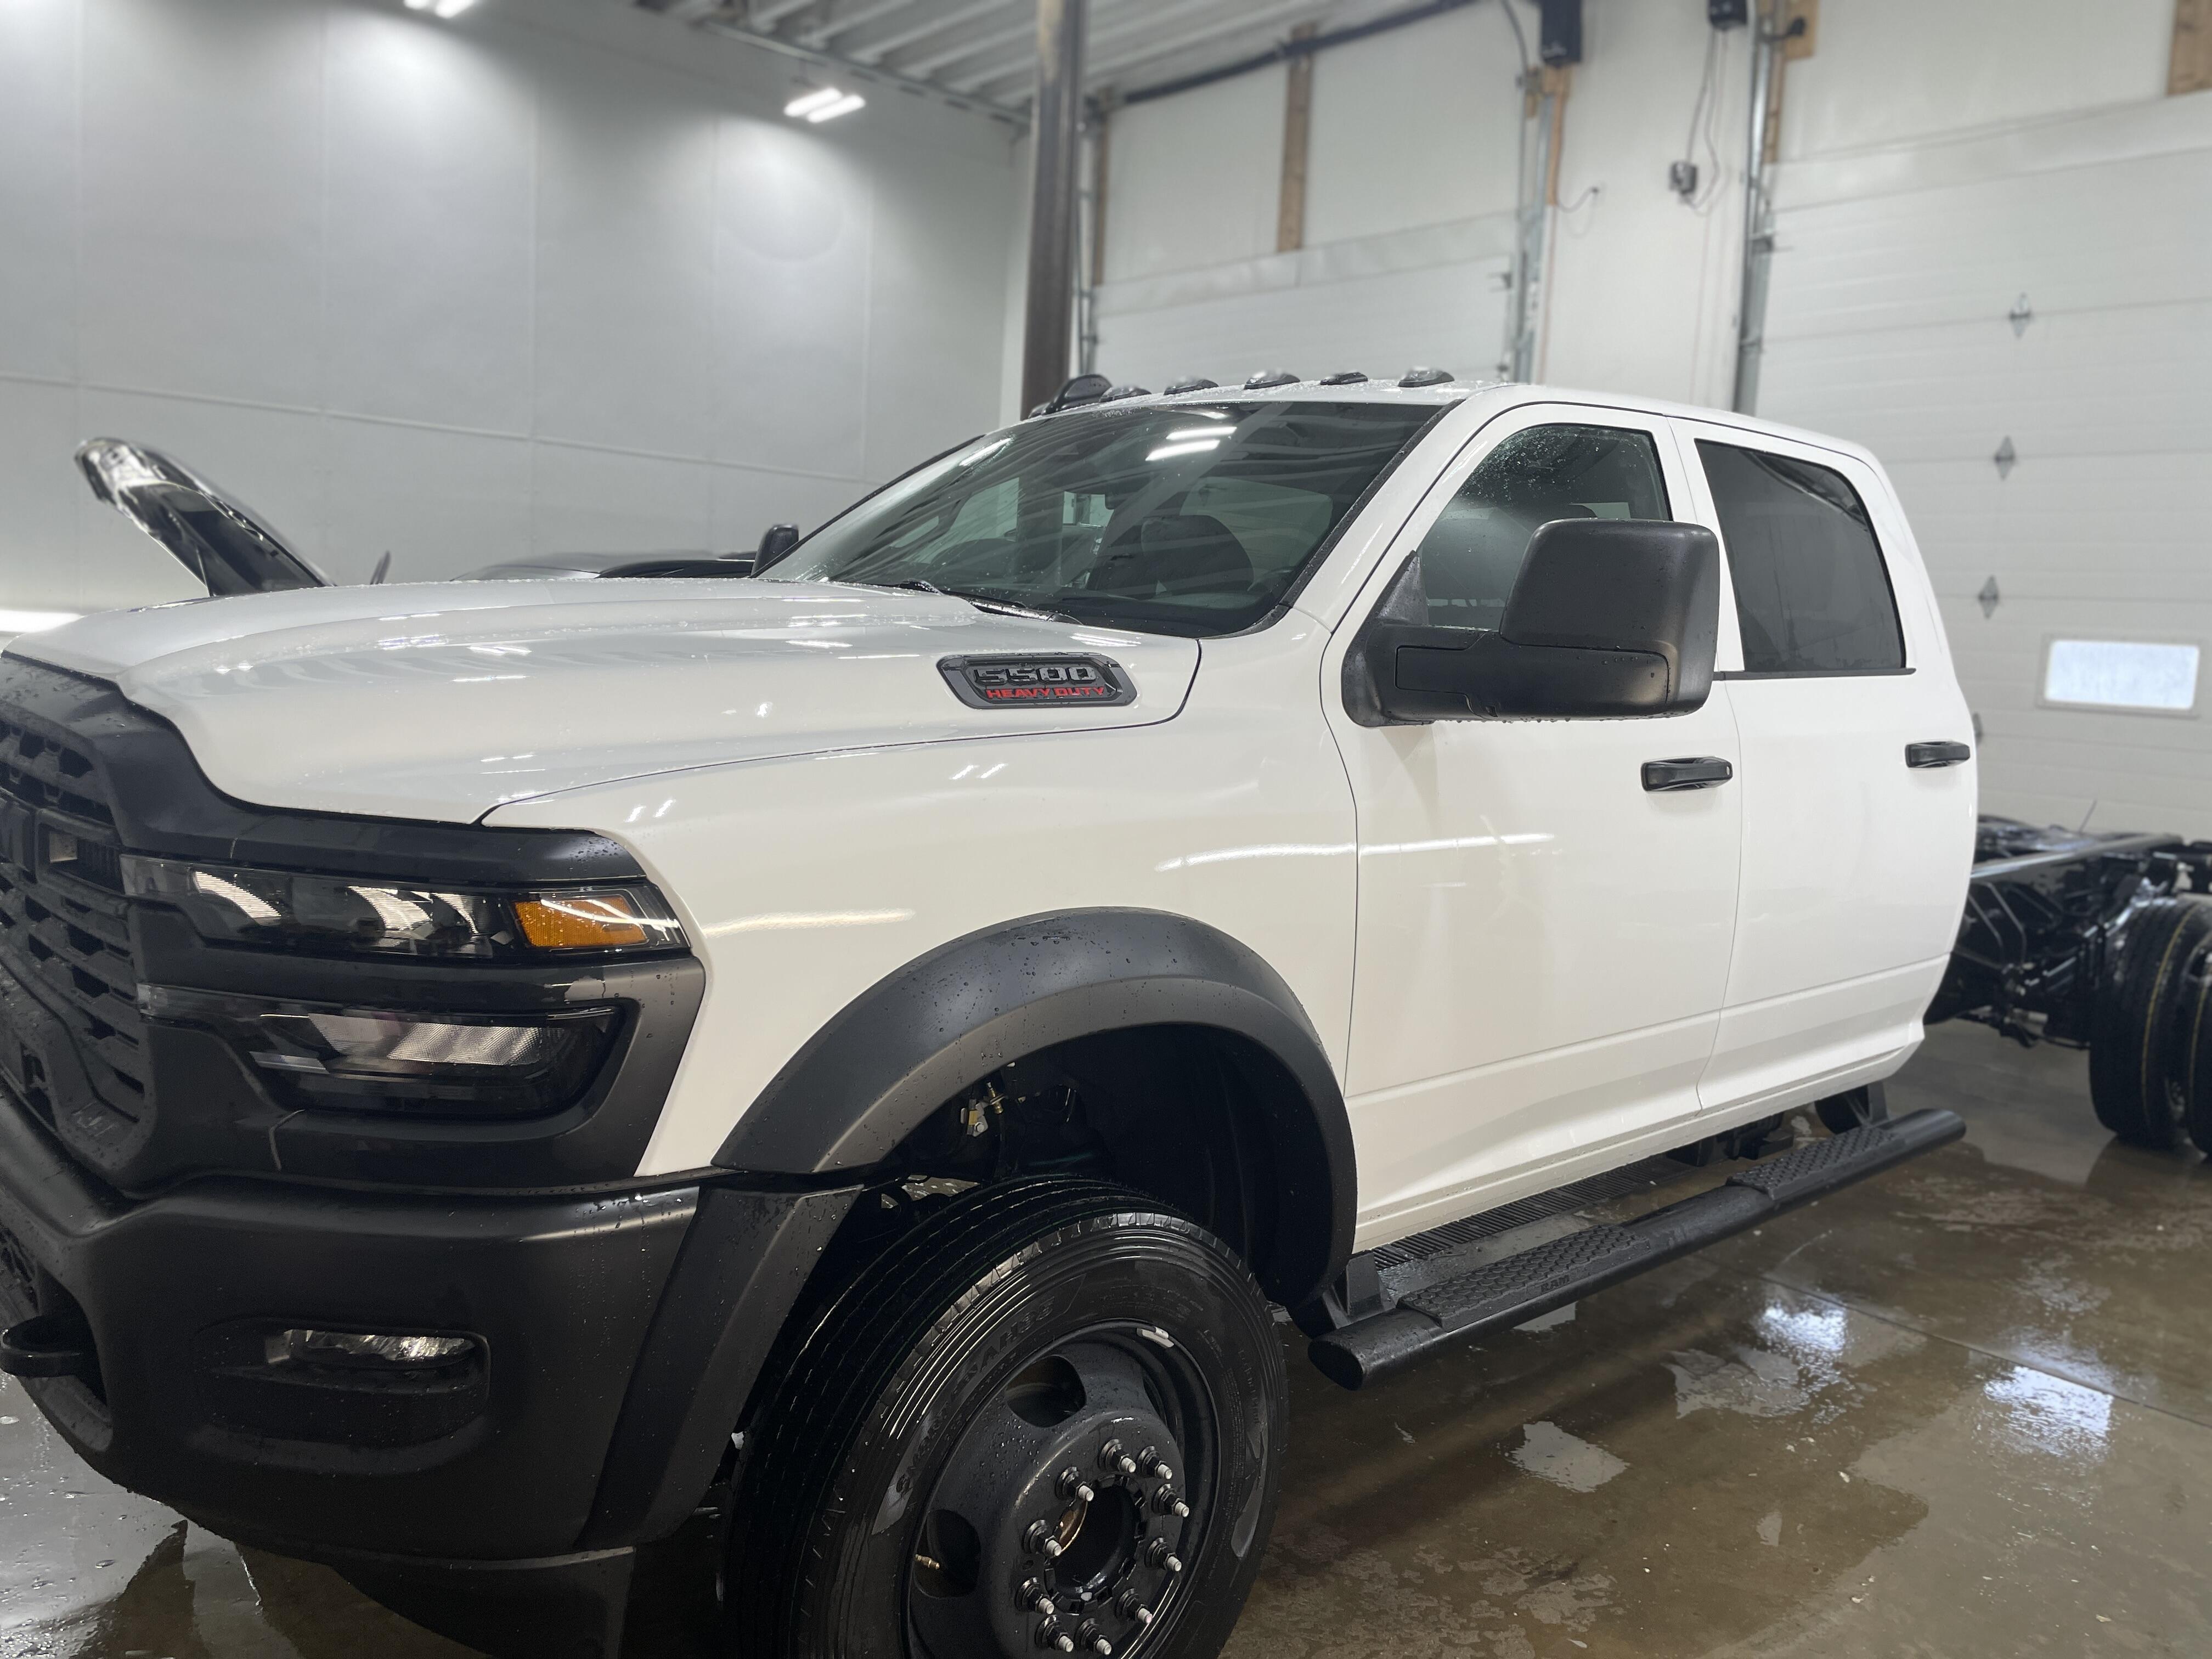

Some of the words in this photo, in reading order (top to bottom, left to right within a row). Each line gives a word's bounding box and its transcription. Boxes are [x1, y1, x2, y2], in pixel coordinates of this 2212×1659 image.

[975, 667, 1096, 683] 5500
[986, 687, 1051, 699] HEAVY
[1053, 686, 1104, 697] DUTY
[1541, 1274, 1570, 1293] RAM
